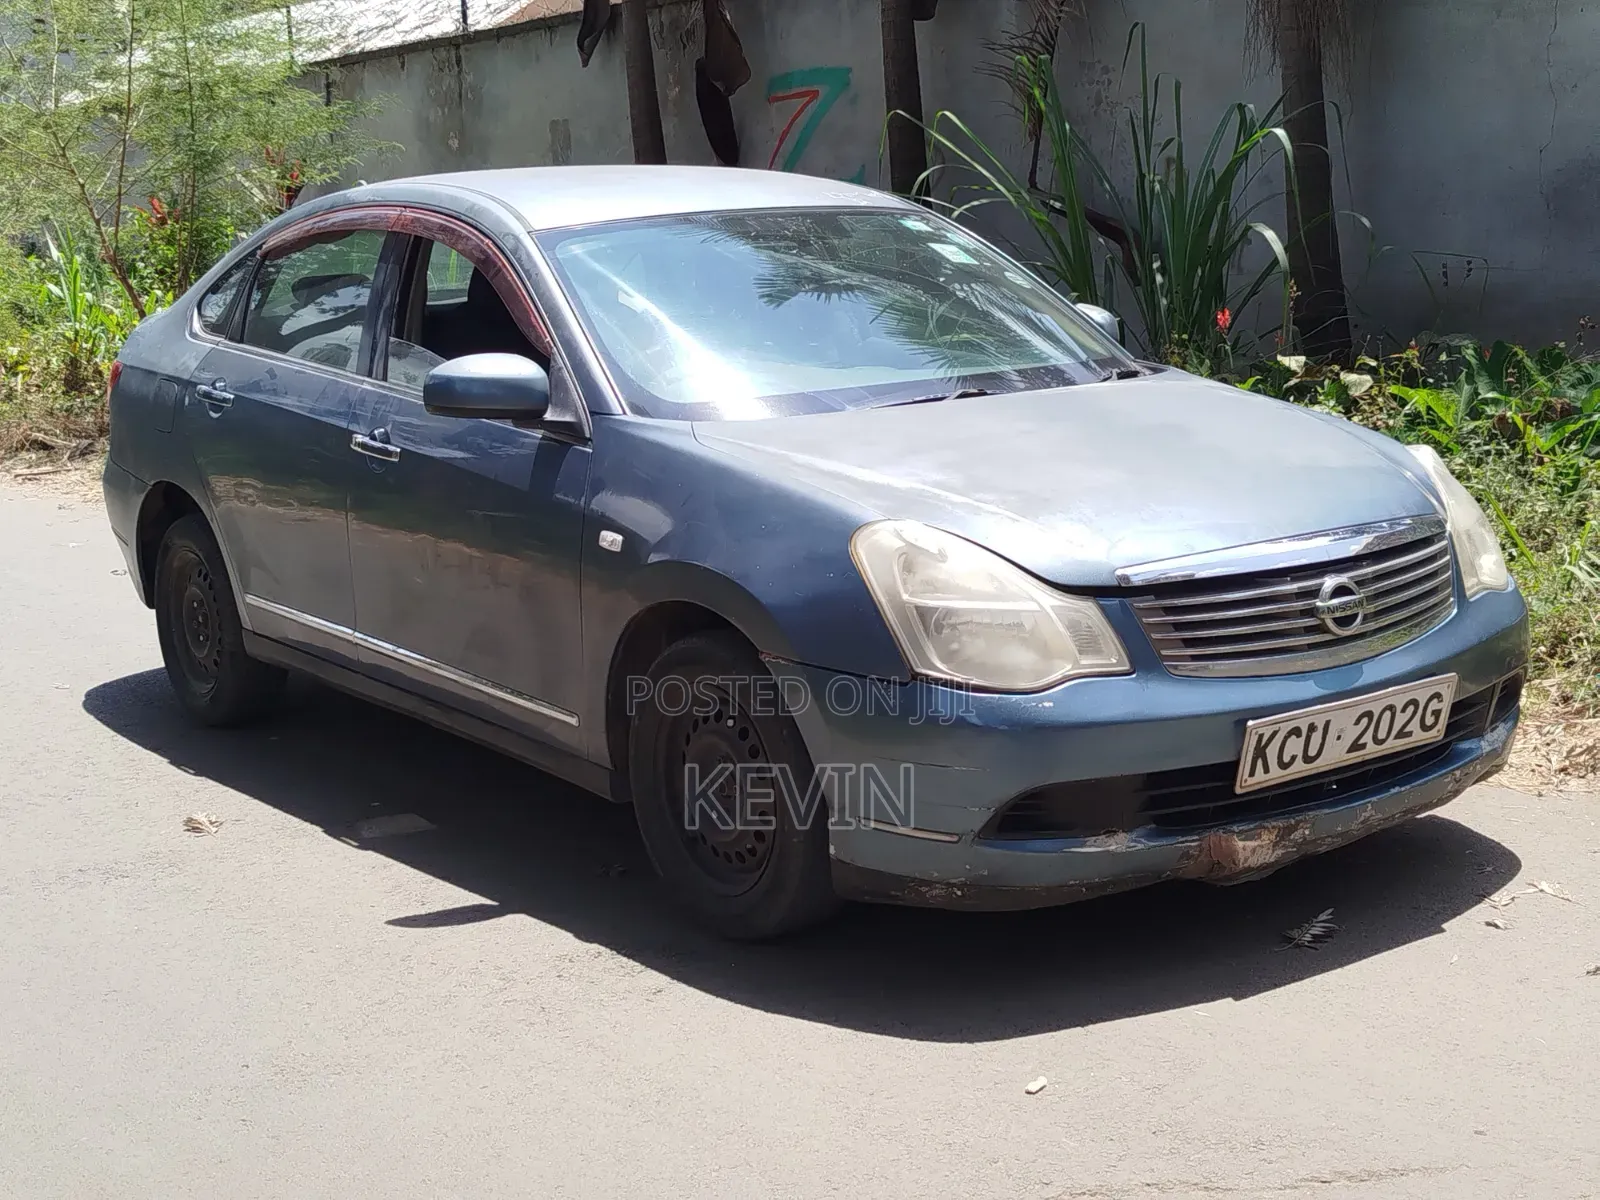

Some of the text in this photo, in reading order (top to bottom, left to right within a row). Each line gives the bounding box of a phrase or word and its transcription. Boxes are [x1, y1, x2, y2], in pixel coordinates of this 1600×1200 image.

[1326, 599, 1364, 615] NISSAN
[1248, 691, 1444, 778] KCU 202G
